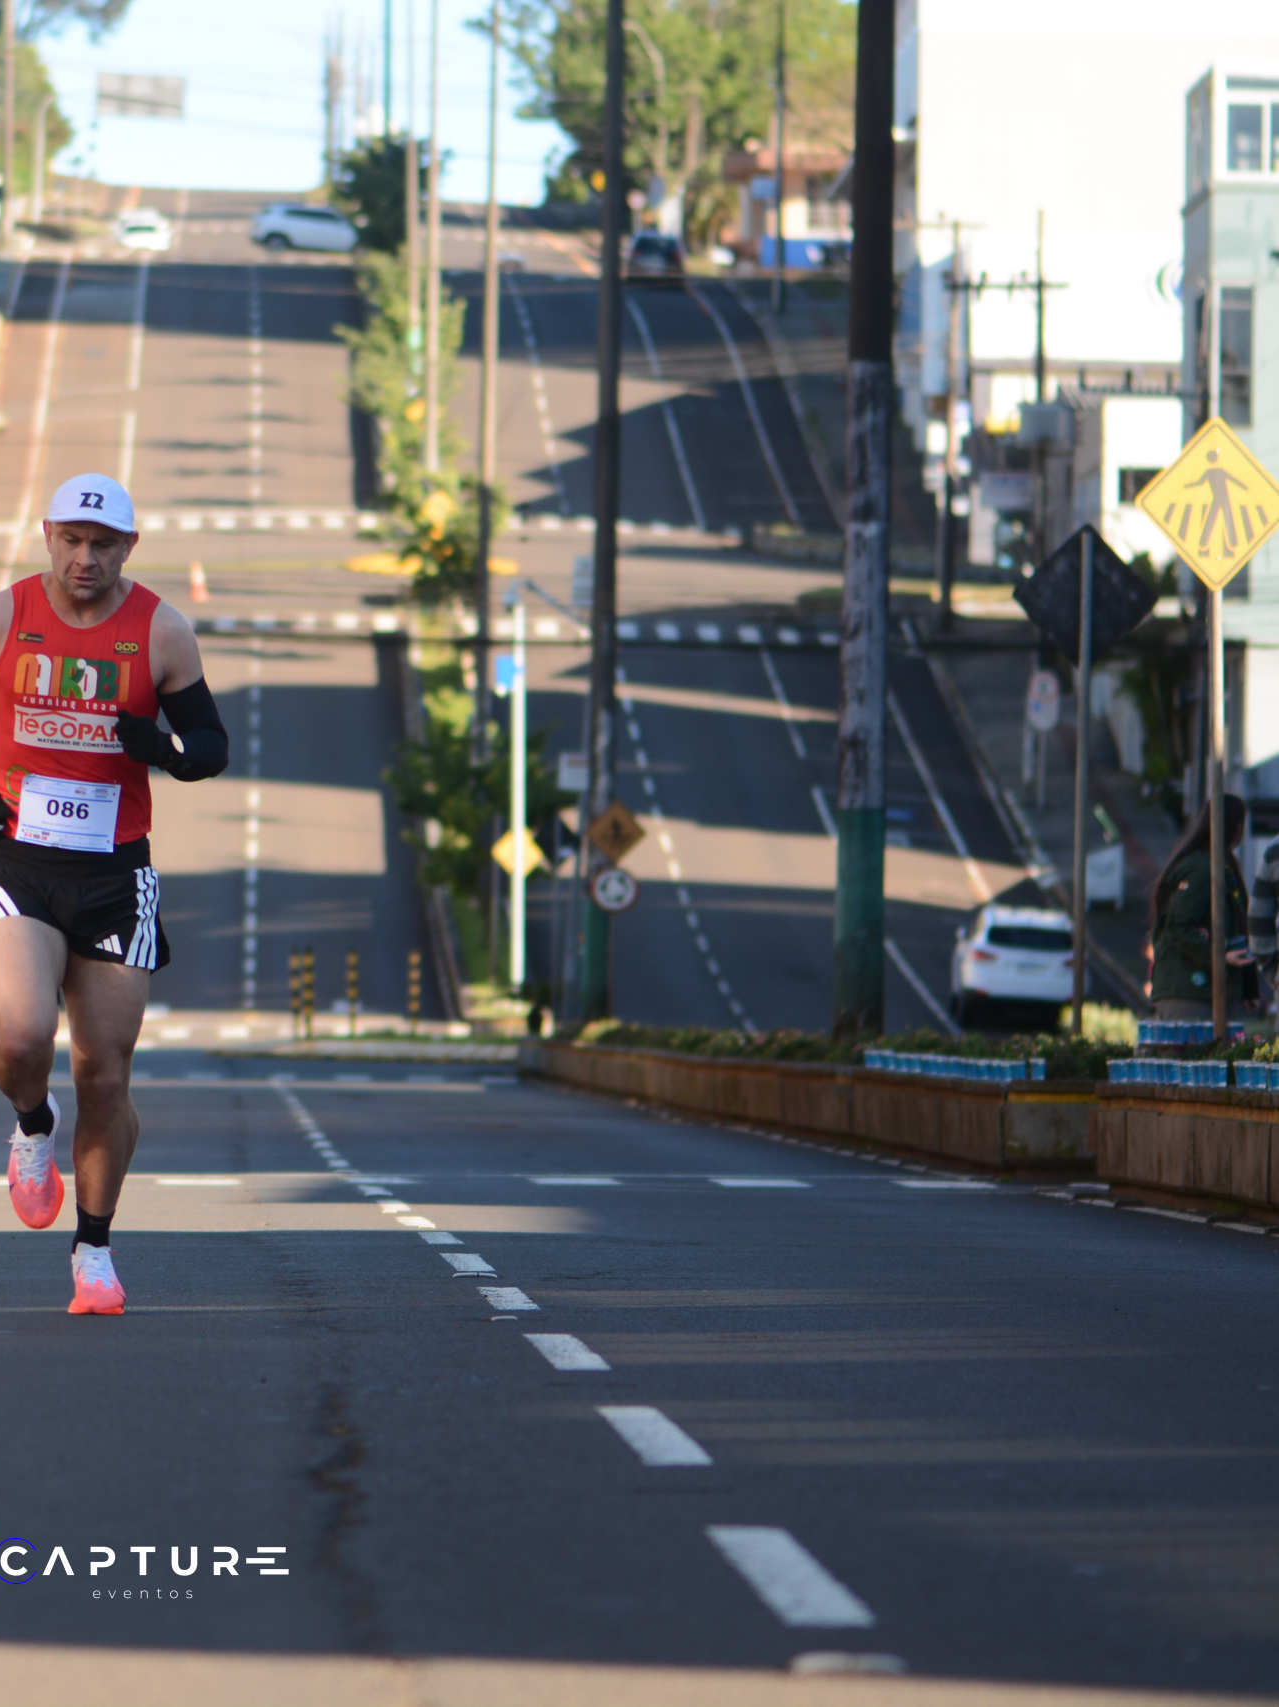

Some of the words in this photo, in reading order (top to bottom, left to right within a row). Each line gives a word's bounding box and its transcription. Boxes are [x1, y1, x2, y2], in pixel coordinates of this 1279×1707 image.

[23, 695, 76, 710] running
[86, 701, 117, 712] team
[37, 737, 71, 746] MATERIAIS
[46, 799, 90, 820] 086
